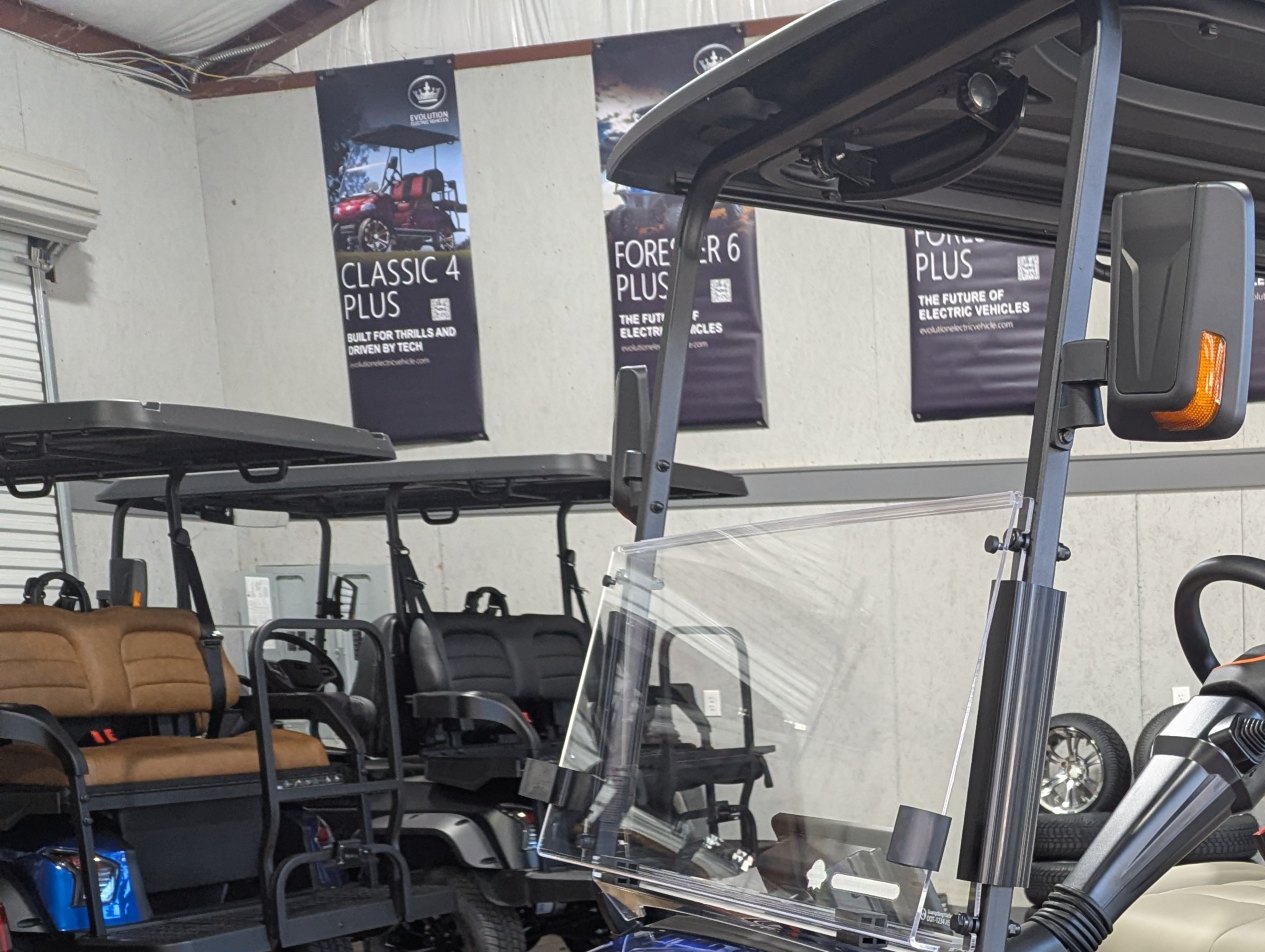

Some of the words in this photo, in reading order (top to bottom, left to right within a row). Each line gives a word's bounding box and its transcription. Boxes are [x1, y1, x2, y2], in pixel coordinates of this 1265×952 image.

[410, 111, 449, 122] EVOLUTION
[615, 234, 721, 269] FORER
[727, 233, 740, 262] 6
[341, 256, 438, 289] CLASSIC
[445, 254, 460, 281] 4
[916, 249, 973, 282] PLUS
[616, 271, 669, 301] PLUS
[343, 290, 400, 320] PLUS
[918, 293, 940, 307] THE
[942, 290, 986, 304] FUTURE
[988, 289, 1004, 301] OF
[619, 313, 641, 325] THE
[919, 305, 972, 321] ELECTRIC
[974, 301, 1030, 316] VEHICLES
[346, 331, 372, 343] BUILT
[373, 330, 394, 341] FOR
[394, 327, 435, 339] THRILLS
[435, 326, 458, 337] AND
[919, 320, 1013, 335] evolutionelectricvehicle.com
[348, 344, 381, 356] DRIVEN
[382, 342, 396, 353] BY
[397, 341, 424, 352] TECH
